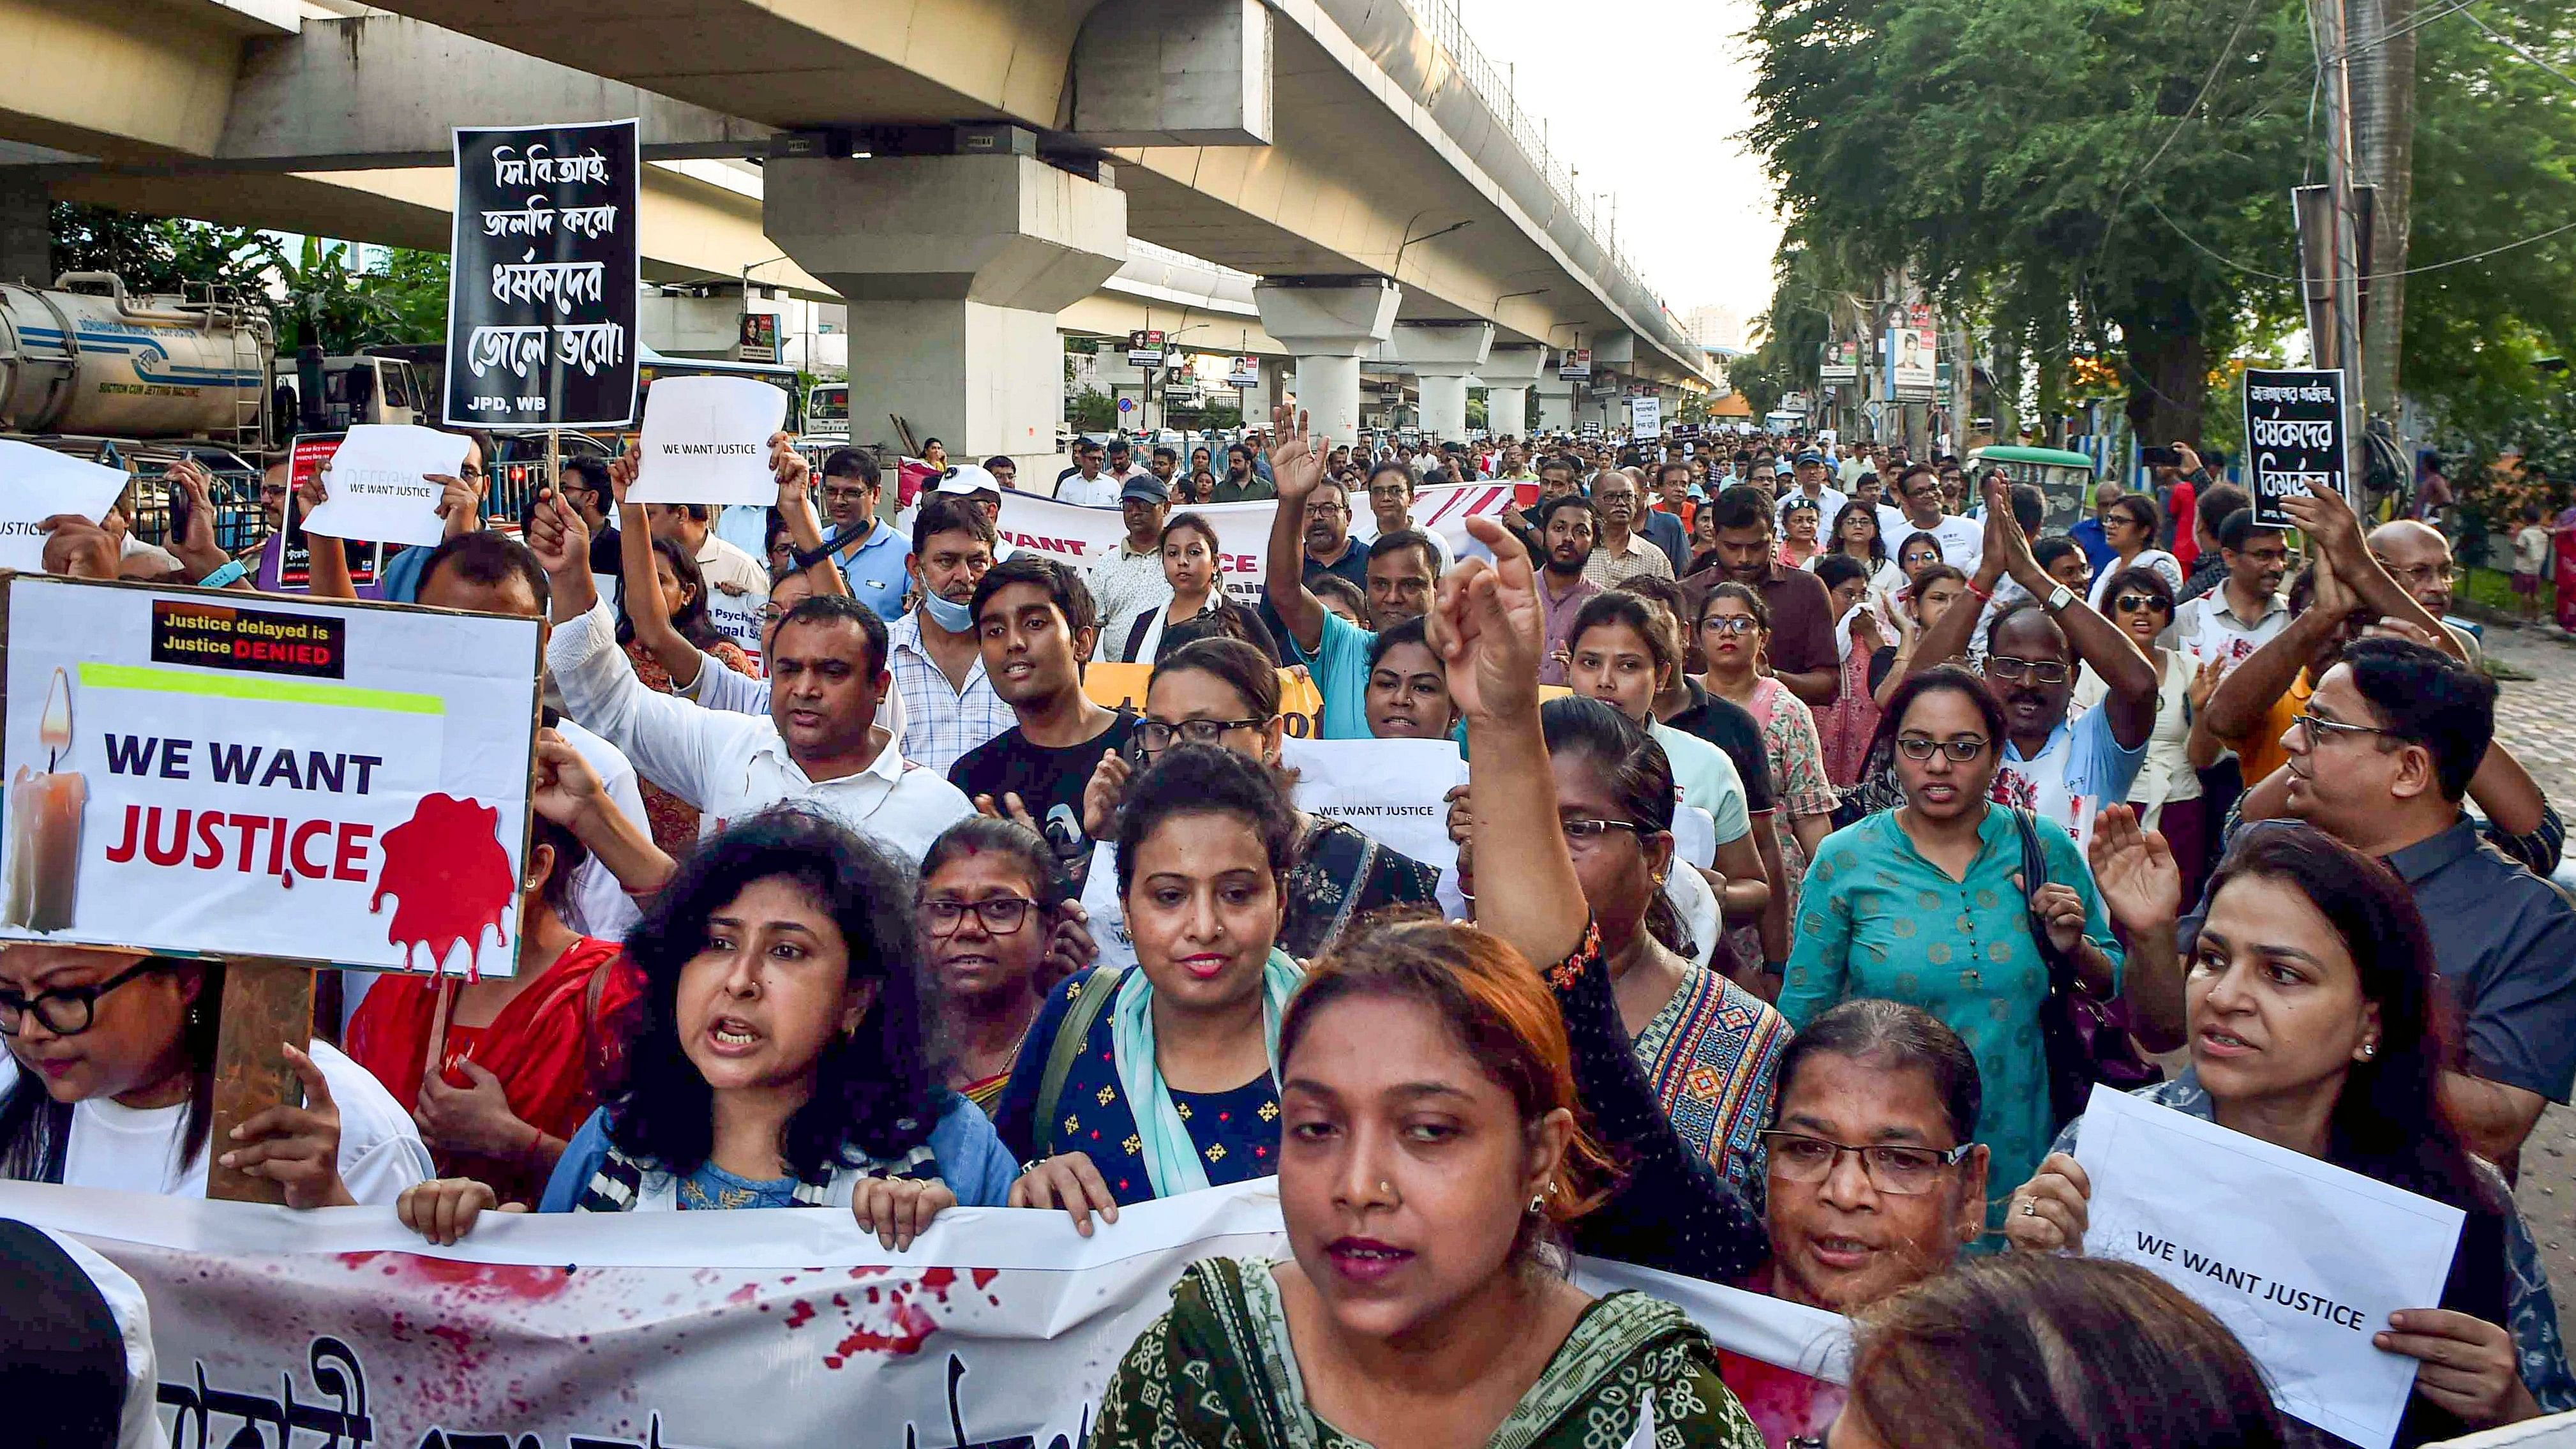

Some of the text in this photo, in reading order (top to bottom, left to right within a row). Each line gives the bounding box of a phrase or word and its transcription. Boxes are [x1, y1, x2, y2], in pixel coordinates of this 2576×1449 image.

[492, 144, 609, 188] সি.বি.আই.
[480, 194, 618, 239] জলদি করো
[491, 246, 606, 315] ধর্ষকদের
[467, 319, 624, 378] জেলে ভরো!
[467, 396, 546, 414] JPD, WB
[663, 444, 756, 454] WE WANT JUSTICE
[2253, 406, 2333, 452] ধর্ষকদের
[350, 483, 431, 498] WE WANT JUSTICE
[163, 613, 329, 640] Justice delayed is
[163, 635, 331, 666] Justice DENIED
[104, 733, 382, 795] WE WANT
[1319, 806, 1434, 816] WE WANT JUSTICE
[105, 804, 374, 883] JUSTICE
[2137, 1231, 2365, 1332] WE WANT JUSTICE
